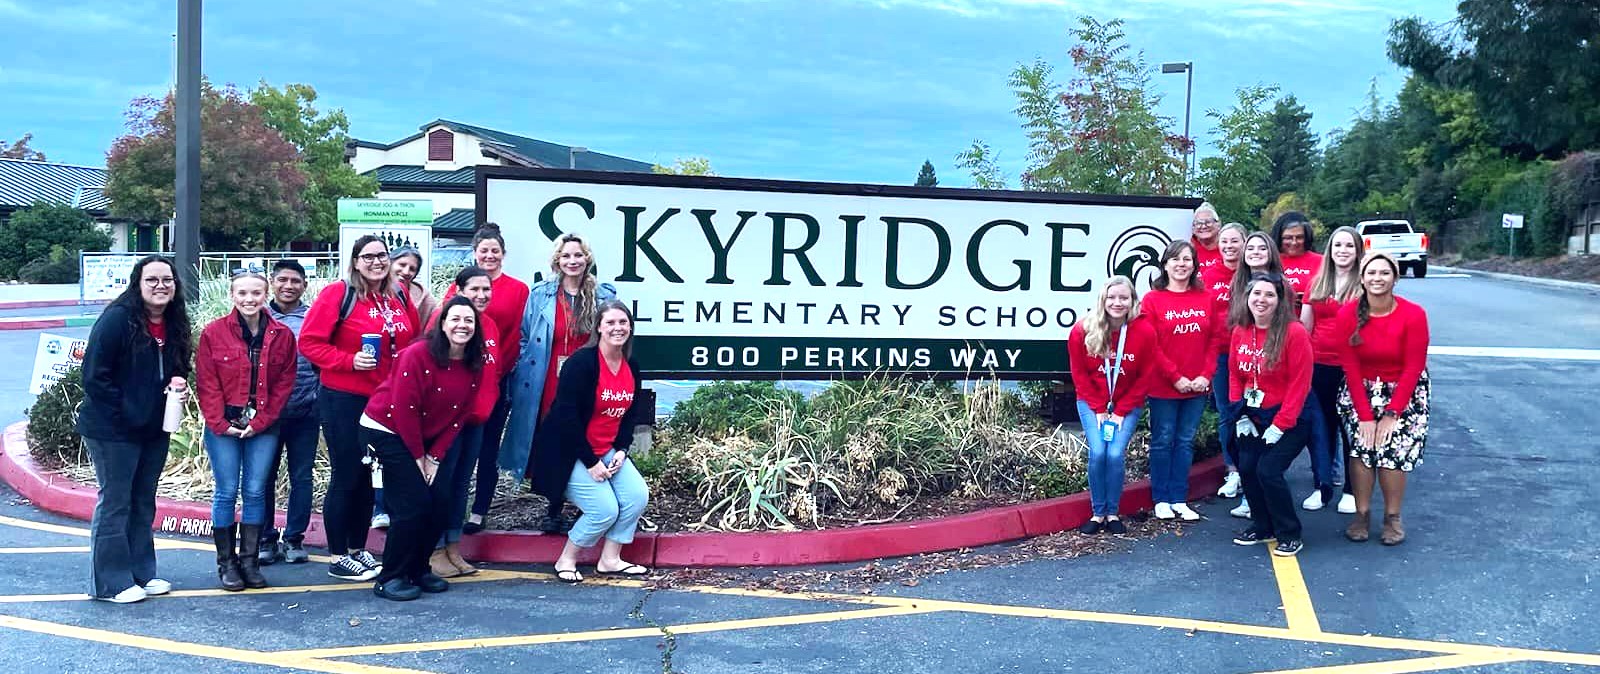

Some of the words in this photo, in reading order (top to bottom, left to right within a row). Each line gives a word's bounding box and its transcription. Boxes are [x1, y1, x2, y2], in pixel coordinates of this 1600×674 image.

[533, 196, 1092, 292] SKYRIDGE
[632, 300, 912, 326] LEMENTARY
[938, 306, 1091, 328] SCHOO
[1173, 322, 1201, 335] AUTA
[691, 346, 760, 367] 800
[781, 346, 932, 368] PERKINS
[950, 348, 1022, 368] WAY
[161, 515, 177, 532] NO
